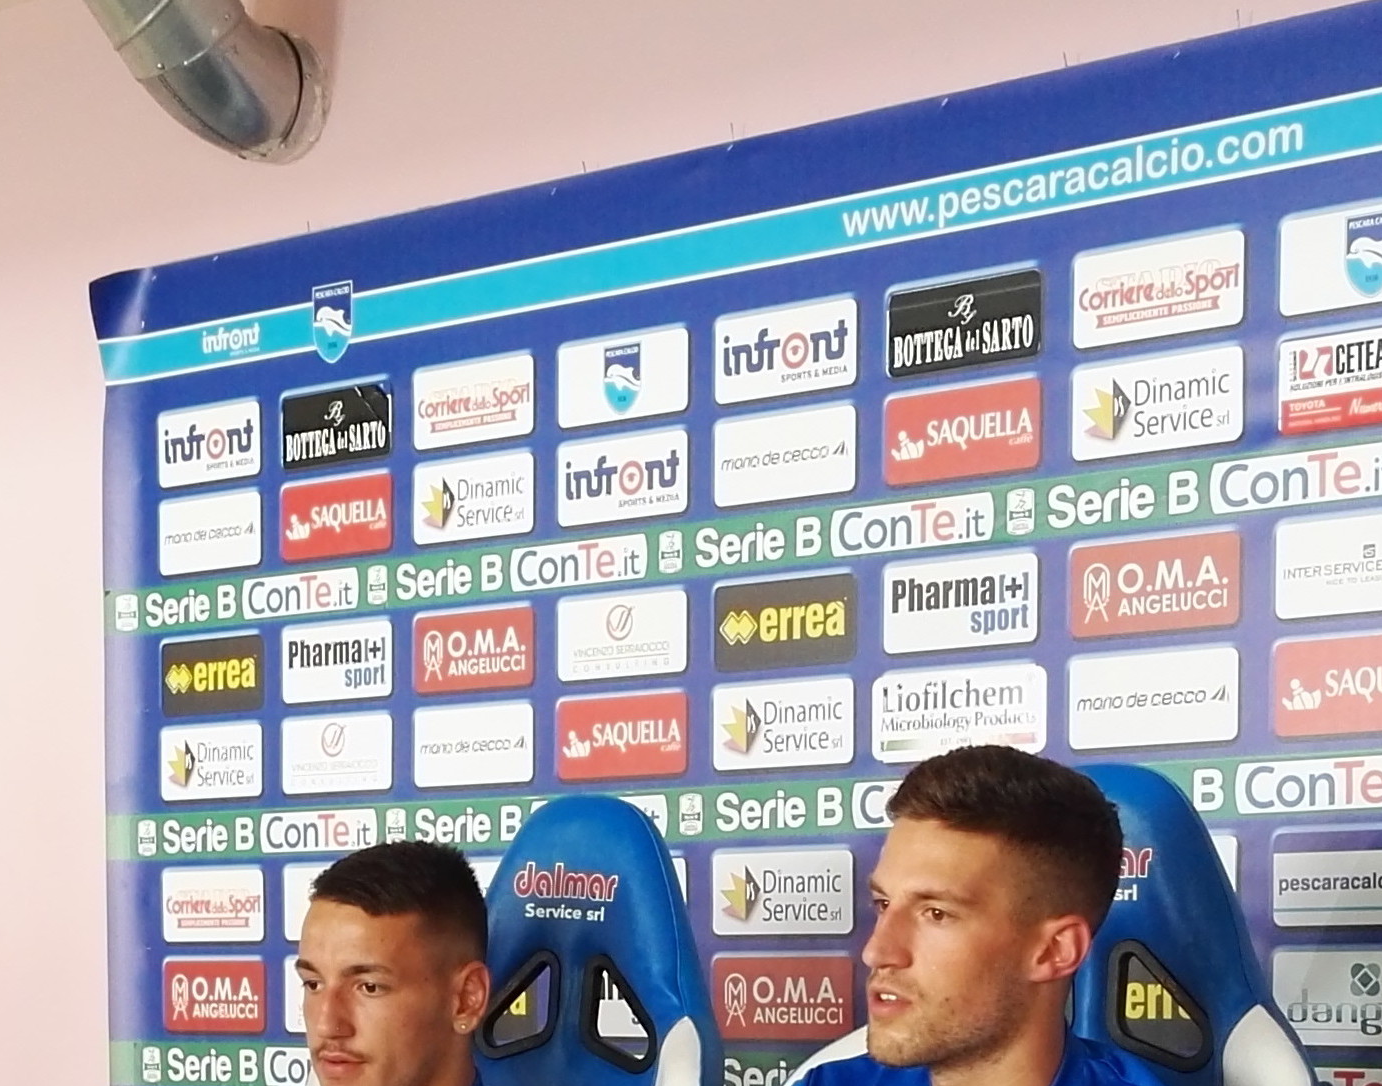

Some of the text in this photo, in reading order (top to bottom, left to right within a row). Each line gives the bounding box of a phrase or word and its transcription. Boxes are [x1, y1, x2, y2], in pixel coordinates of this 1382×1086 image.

[842, 121, 1305, 238] www.pescaracalcio.com
[1078, 281, 1155, 315] Corriere
[1185, 262, 1241, 304] Sport
[202, 321, 260, 355] infront
[723, 320, 848, 377] infront
[894, 331, 963, 369] BOTTEGA
[982, 315, 1034, 354] SARTO
[418, 383, 529, 419] Corriere Sport
[1133, 369, 1231, 406] Dinamic
[927, 408, 1034, 454] SAQUELLA
[1133, 406, 1231, 438] Service srl
[165, 419, 253, 464] infront
[286, 420, 385, 462] BOTTEGA SARTO
[457, 472, 525, 502] Dinamic
[566, 450, 680, 500] infront
[311, 498, 386, 533] SAQUELLA
[456, 496, 513, 529] Service
[1047, 479, 1155, 529] Serie
[1168, 471, 1199, 515] B
[695, 502, 986, 568] Serie B ConTe.it
[396, 542, 642, 600] Serie B ConTe.it
[1117, 555, 1229, 594] O.M.A.
[1283, 564, 1323, 581] INTER
[145, 574, 353, 628] Serie B ConTe.it
[1117, 588, 1228, 618] ANGELUCCI
[970, 604, 1030, 636] sport
[447, 626, 527, 658] O.M.A.
[344, 663, 386, 690] sport
[447, 654, 526, 677] ANGELUCCI
[763, 695, 844, 725] Dinamic
[881, 678, 1024, 714] Liofilchem
[1076, 689, 1208, 711] mario de cecco
[592, 717, 682, 754] SAQUELLA
[763, 725, 829, 754] Service
[880, 712, 973, 735] Microbiology
[197, 740, 254, 763] Dinamic
[197, 764, 244, 788] Service
[1193, 768, 1224, 812] B
[415, 805, 522, 844] Serie B
[716, 790, 806, 833] Serie
[817, 786, 843, 828] B
[163, 814, 371, 854] Serie B ConTe.it
[514, 861, 618, 902] dalmar
[763, 869, 843, 896] Dinamic
[166, 895, 211, 916] Corriere
[524, 903, 606, 922] Service srl
[762, 896, 843, 922] Service srl
[192, 976, 259, 1002] O.M.A.
[753, 976, 844, 1005] O.M.A.
[192, 1000, 258, 1020] ANGELUCCI
[753, 1002, 843, 1026] ANGELUCCI
[167, 1047, 232, 1083] Serie
[239, 1049, 259, 1083] B
